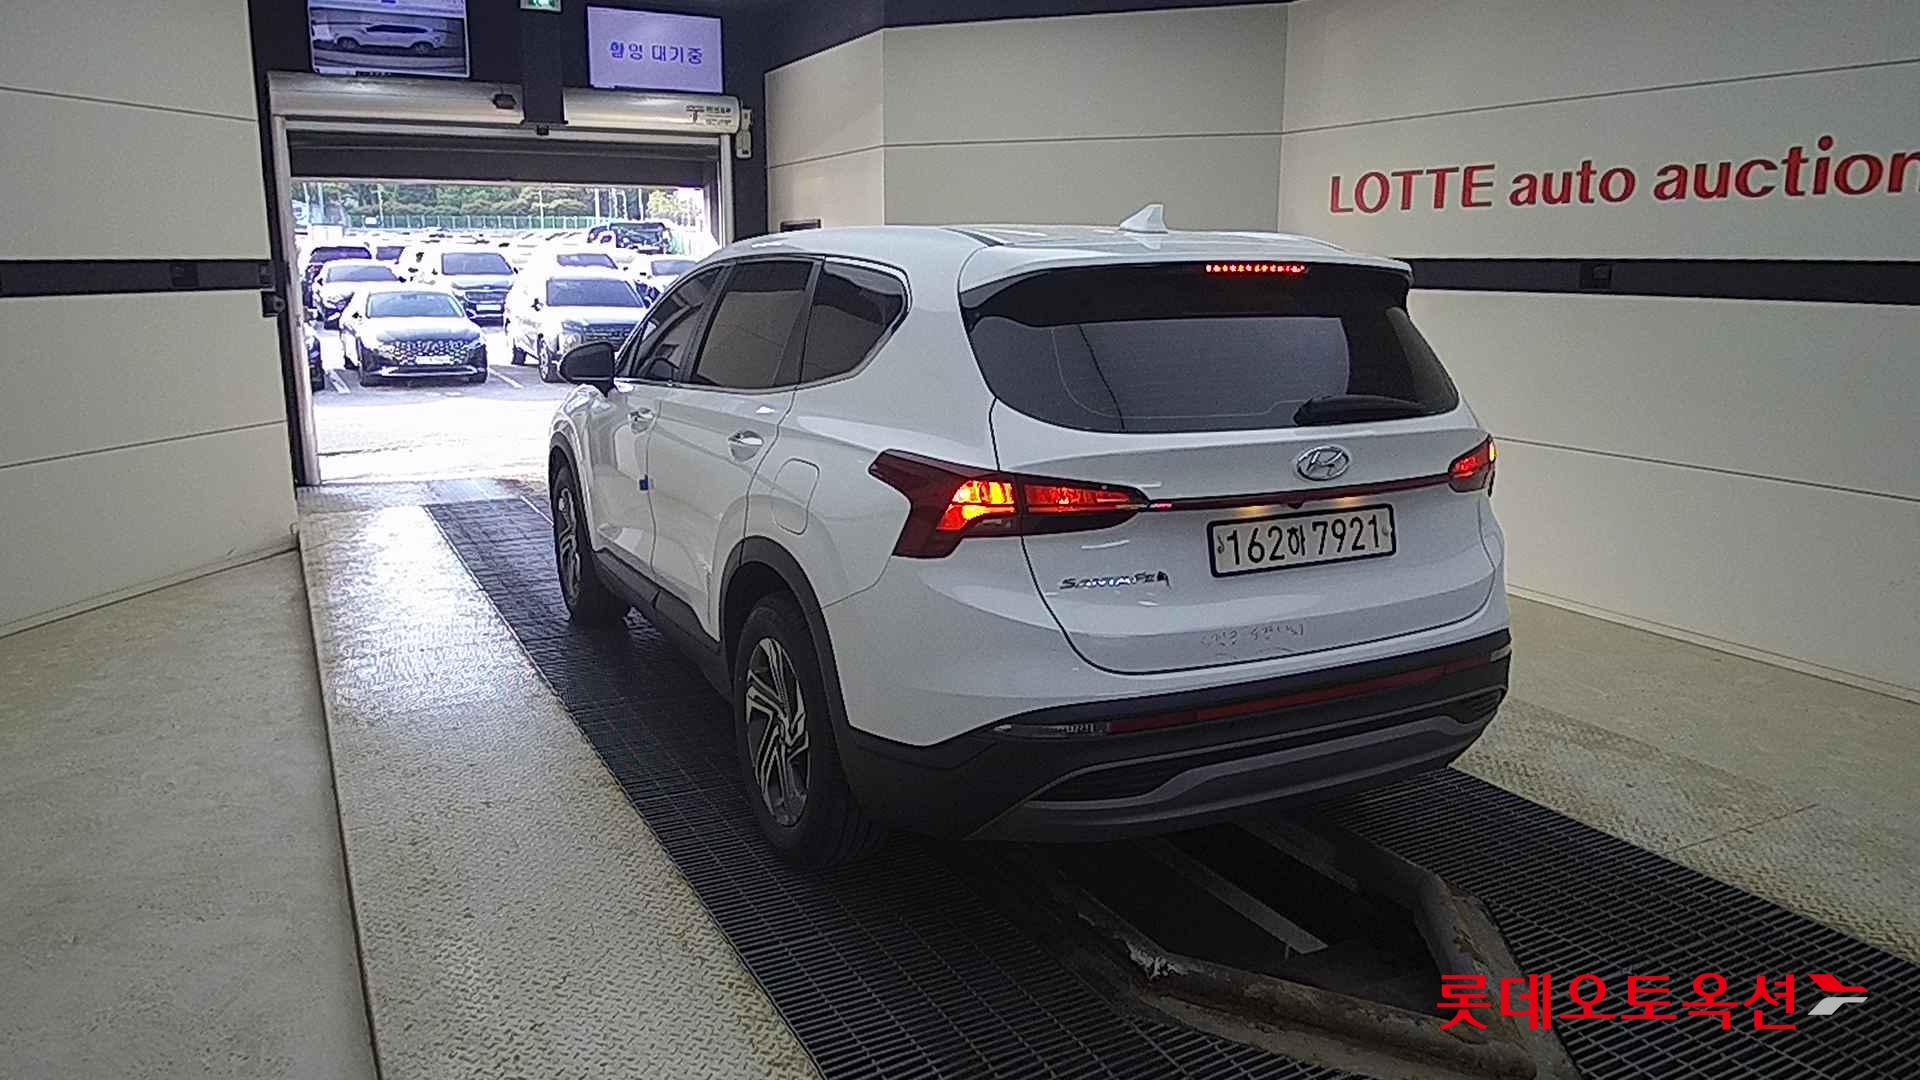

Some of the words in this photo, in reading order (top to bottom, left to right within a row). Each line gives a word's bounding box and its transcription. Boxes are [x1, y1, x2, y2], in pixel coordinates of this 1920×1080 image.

[651, 45, 703, 65] 대기중
[1330, 164, 1495, 213] LOTTE
[1509, 160, 1636, 206] auto
[1653, 135, 1920, 200] auction
